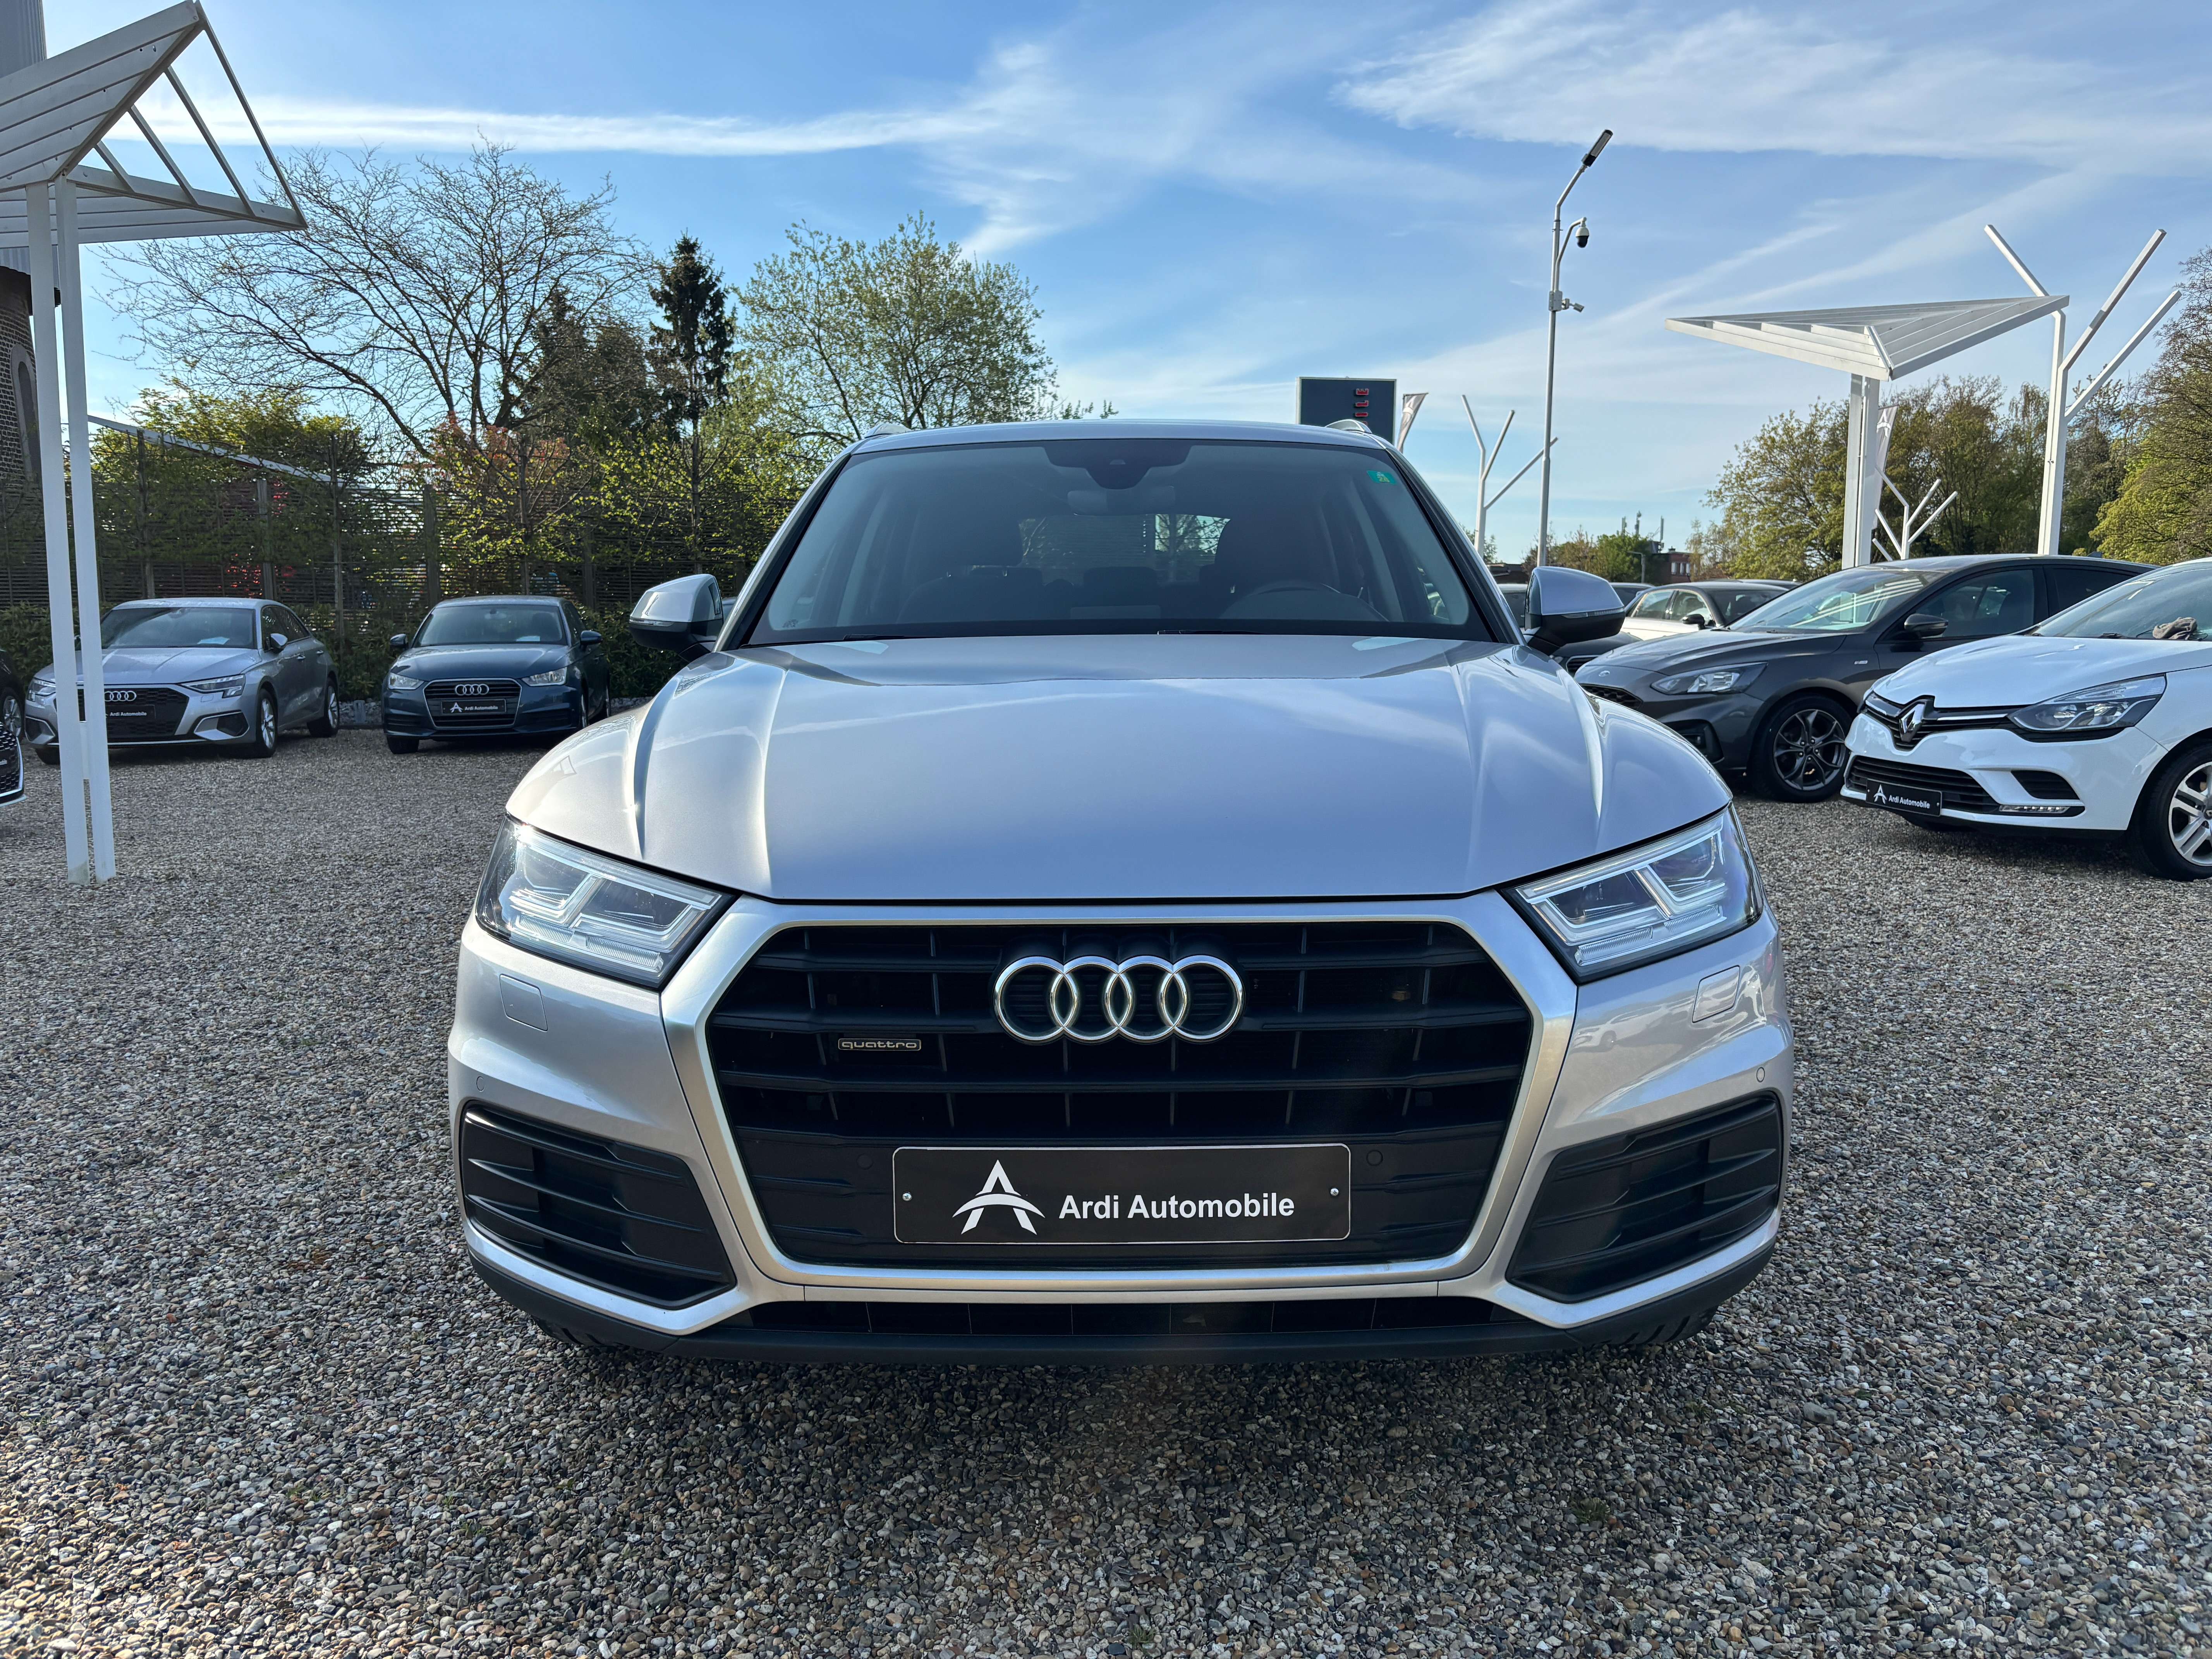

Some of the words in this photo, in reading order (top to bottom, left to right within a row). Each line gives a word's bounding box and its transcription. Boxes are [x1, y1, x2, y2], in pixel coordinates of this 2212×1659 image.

[1355, 388, 1369, 426] ILE
[1888, 795, 1899, 803] Ardi
[1899, 797, 1930, 809] Automobile
[842, 1041, 917, 1049] quattro
[1058, 1195, 1119, 1219] Ardi
[1127, 1192, 1295, 1219] Automobile
